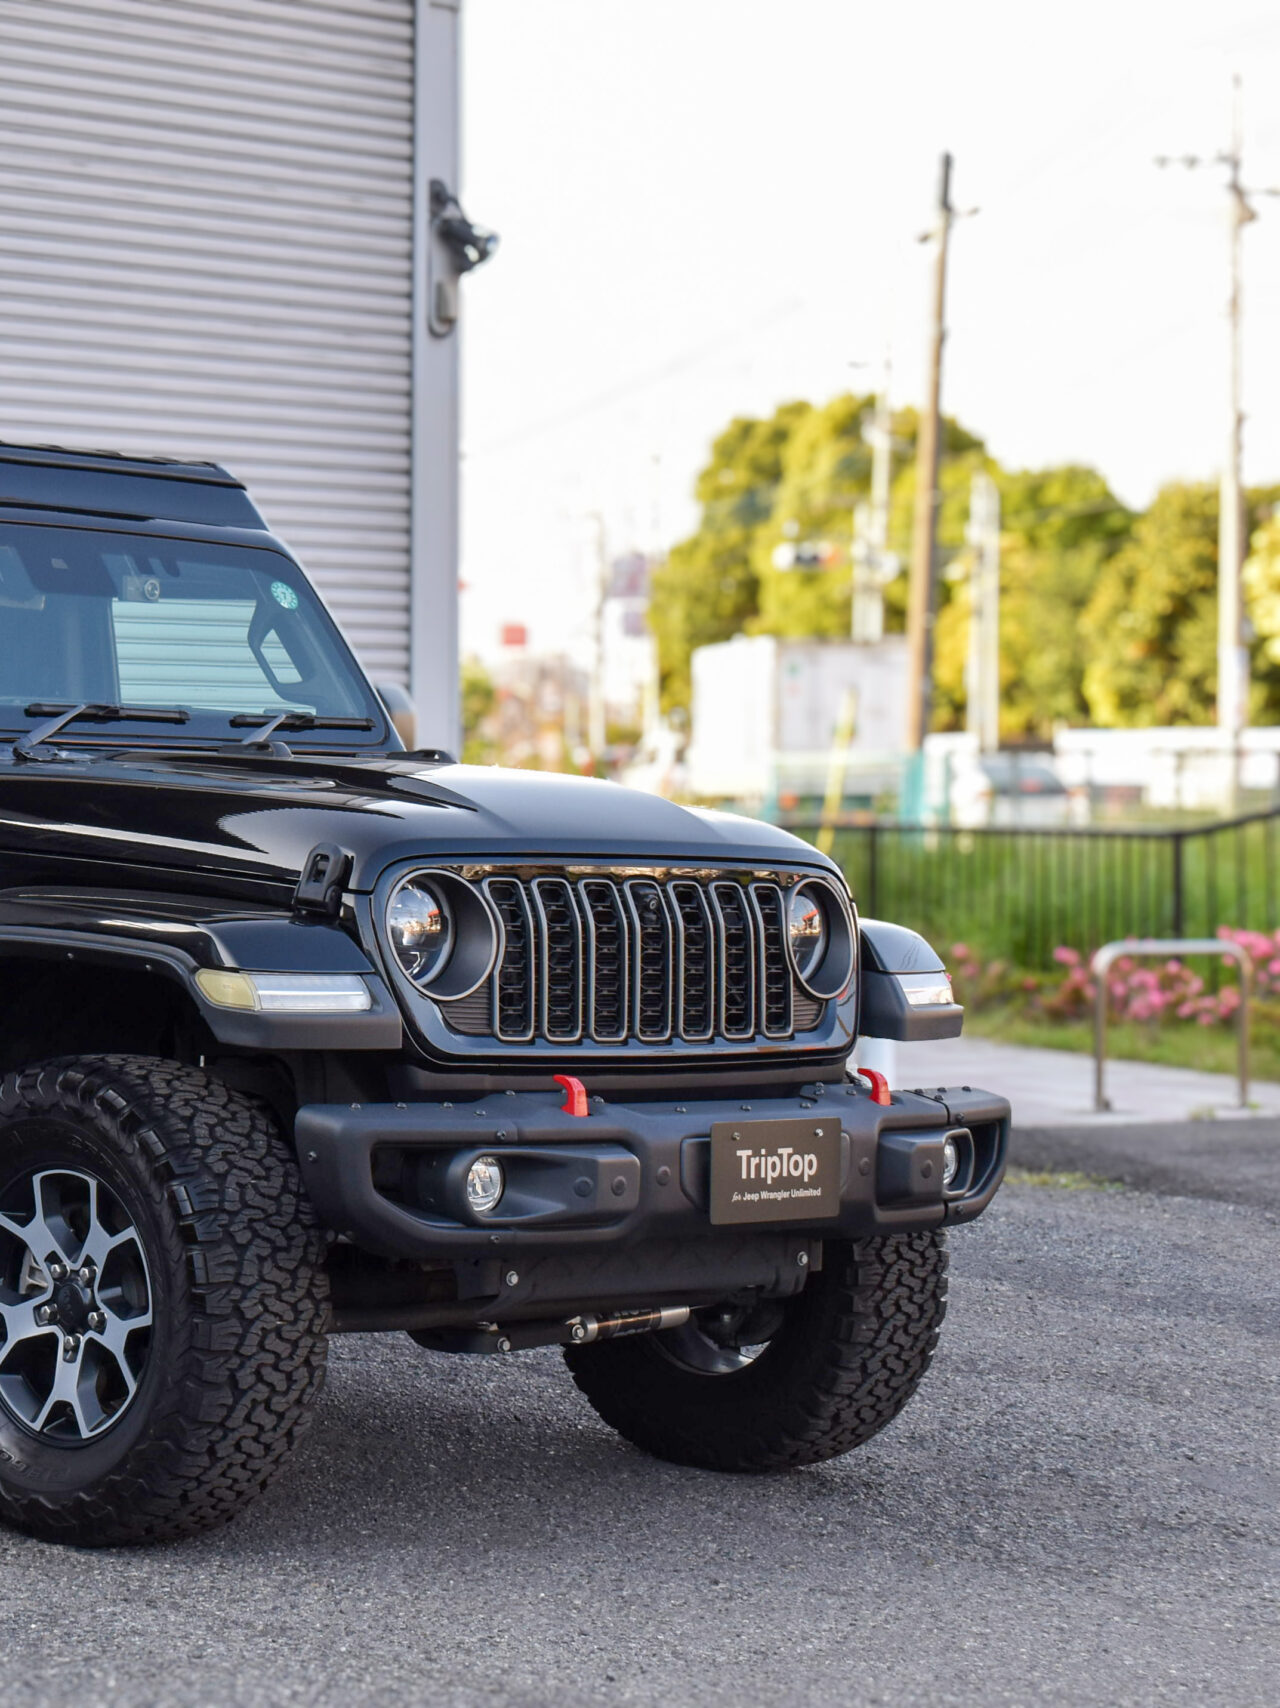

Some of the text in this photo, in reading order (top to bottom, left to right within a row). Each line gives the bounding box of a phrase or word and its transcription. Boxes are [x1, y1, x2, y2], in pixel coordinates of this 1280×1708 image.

[736, 1147, 818, 1184] TripTop
[732, 1187, 821, 1202] for Jeep Wrangler Unlimited
